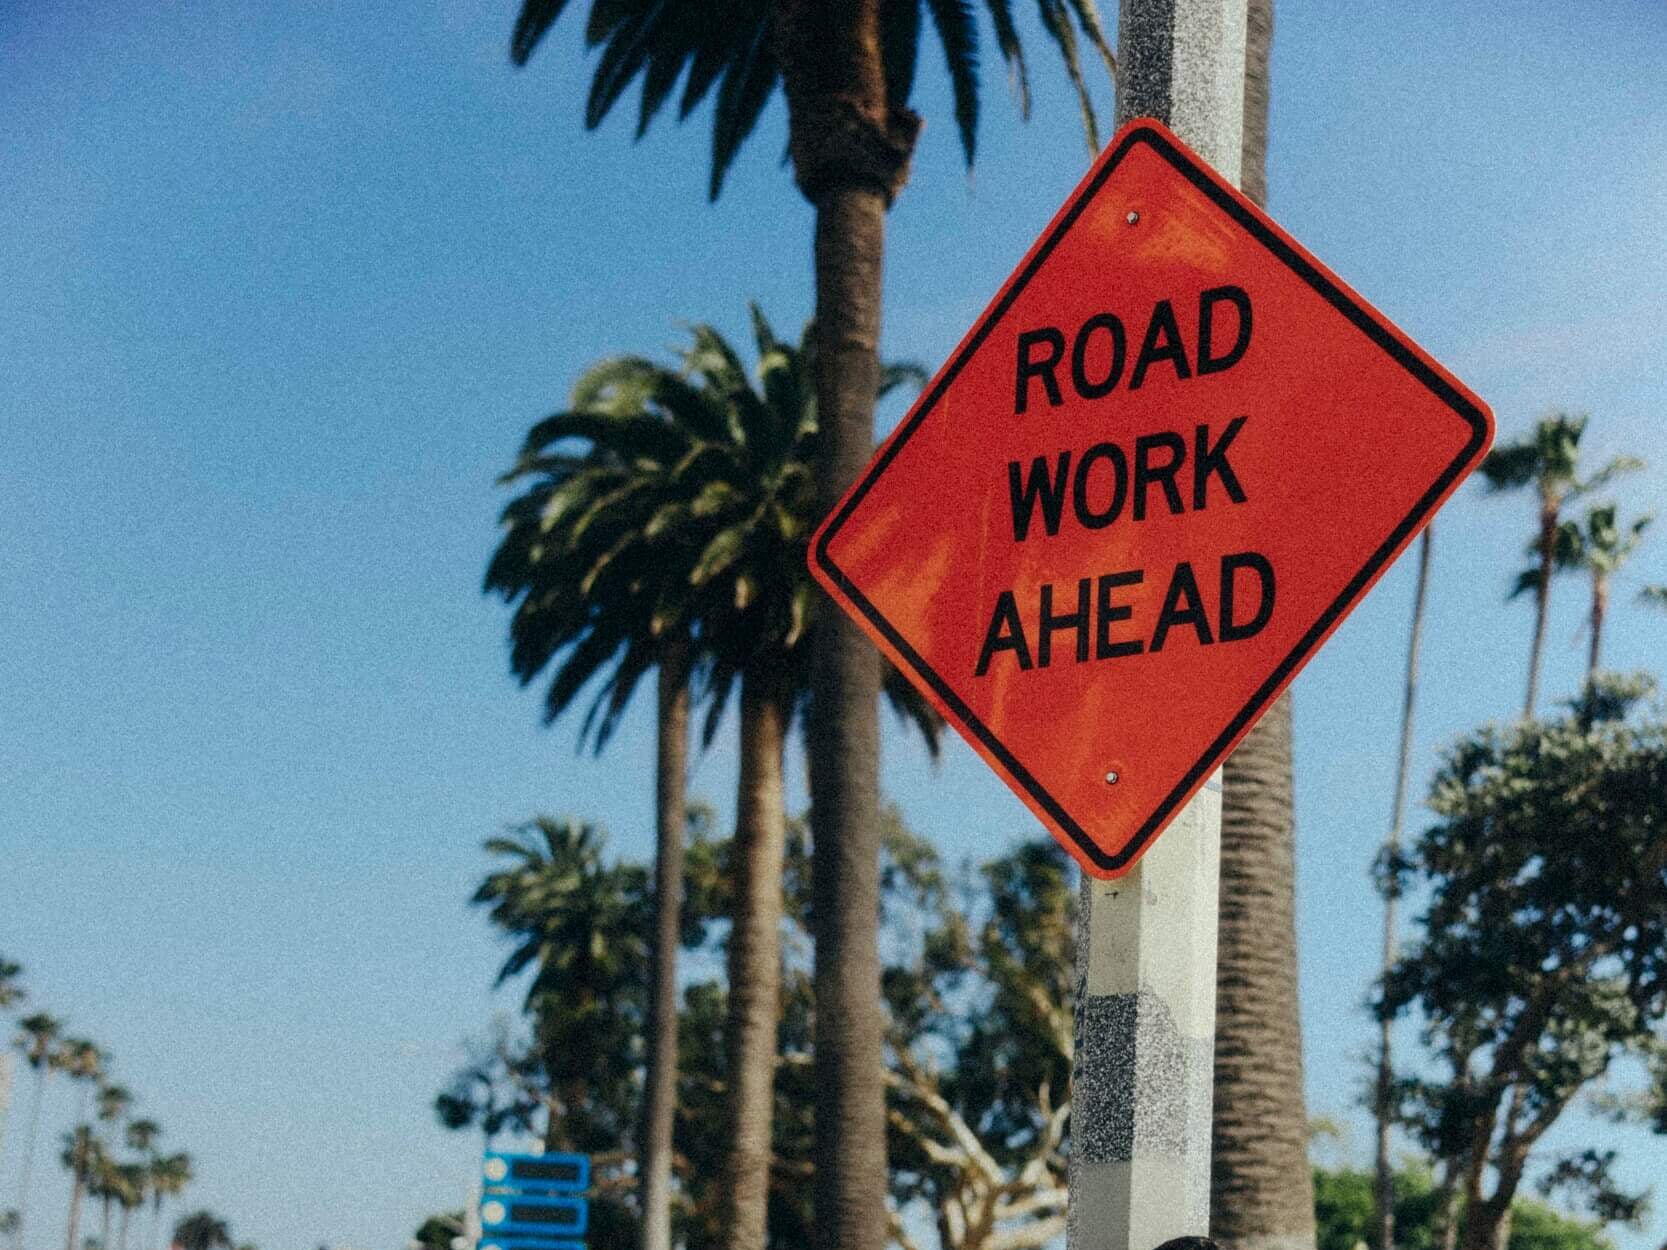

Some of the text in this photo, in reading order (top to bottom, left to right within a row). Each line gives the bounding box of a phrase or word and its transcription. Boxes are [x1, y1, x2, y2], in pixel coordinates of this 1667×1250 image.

[1014, 285, 1253, 414] ROAD
[1007, 416, 1248, 542] WORK
[974, 552, 1277, 677] AHEAD
